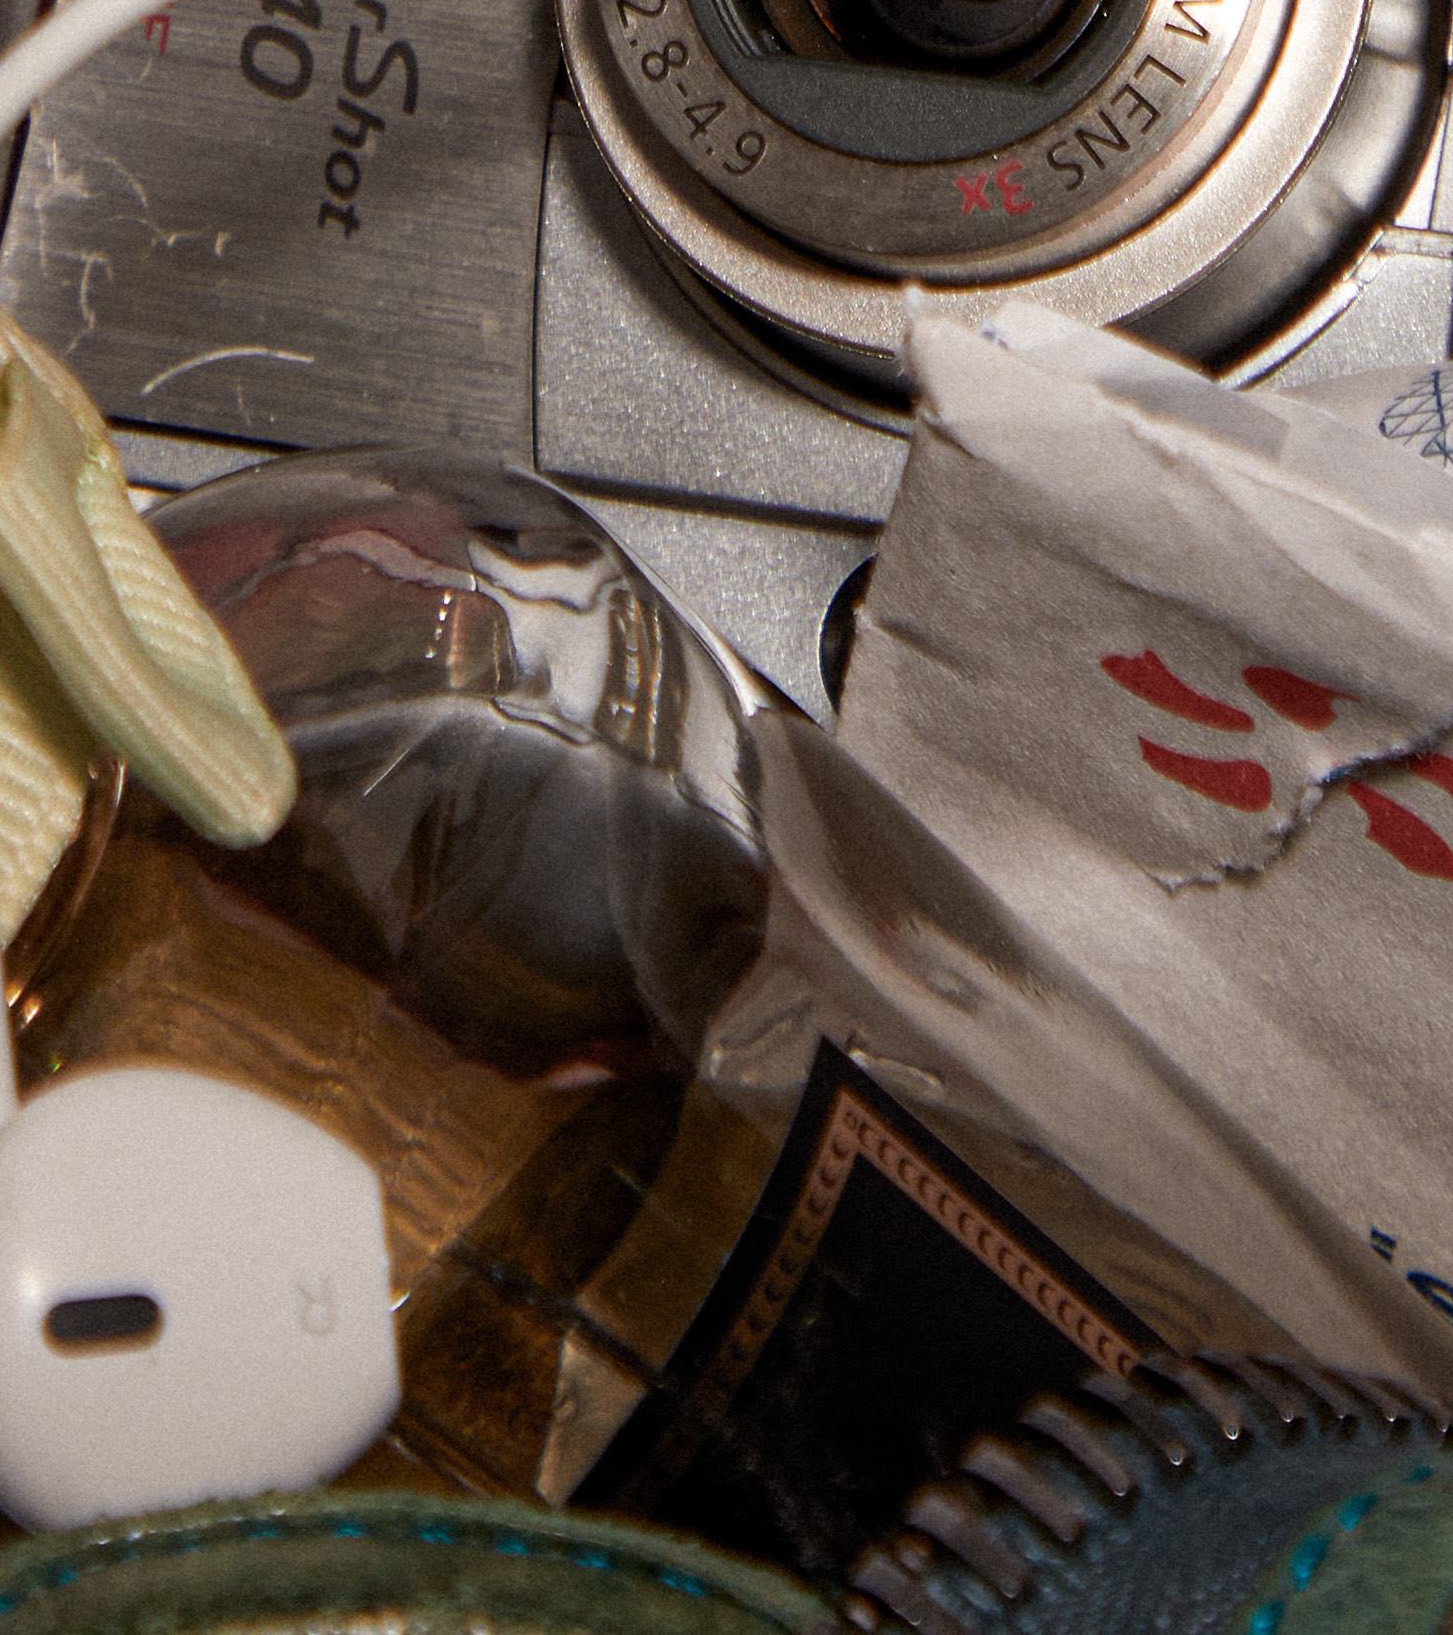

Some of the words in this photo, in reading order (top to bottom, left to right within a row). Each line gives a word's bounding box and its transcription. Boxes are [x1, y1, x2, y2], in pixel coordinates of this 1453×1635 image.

[1043, 53, 1187, 195] LENS
[953, 159, 1036, 220] 3x
[291, 1268, 345, 1340] R
